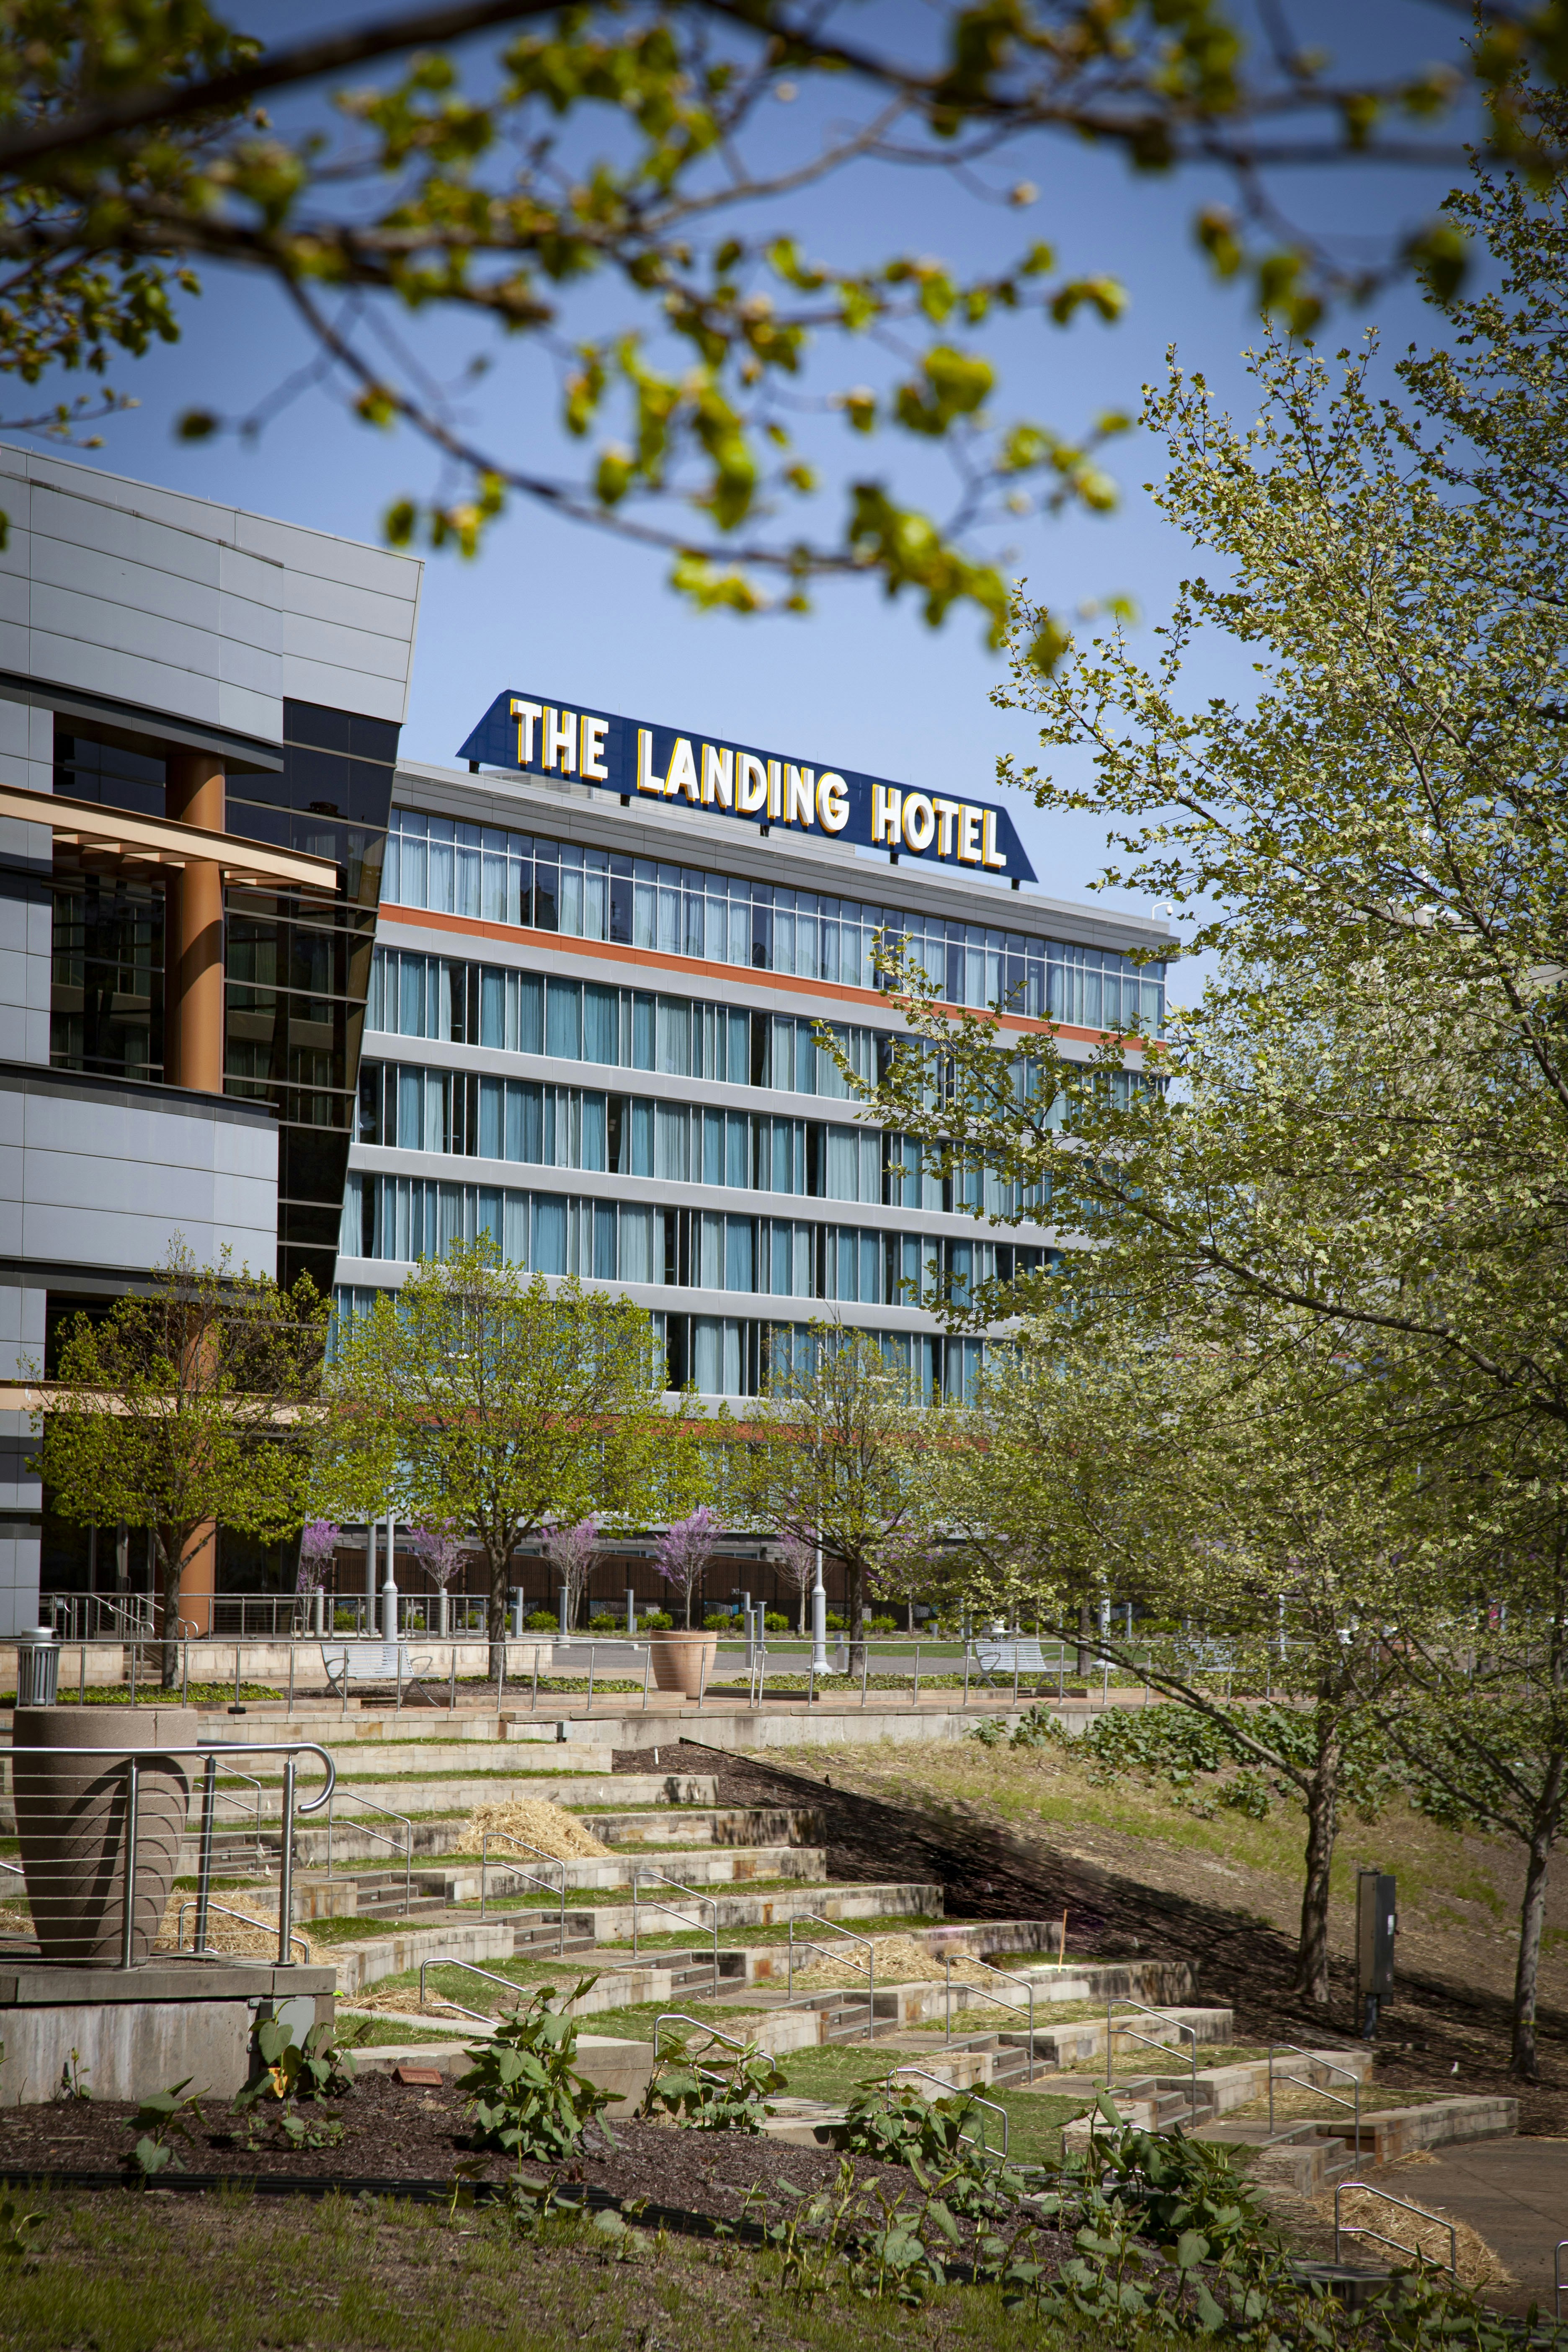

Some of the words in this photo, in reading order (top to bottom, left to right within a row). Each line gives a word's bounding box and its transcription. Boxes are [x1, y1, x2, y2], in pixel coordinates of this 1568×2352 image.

[509, 698, 609, 781] THE
[637, 728, 850, 833] LANDING
[872, 783, 1007, 869] HOTEL
